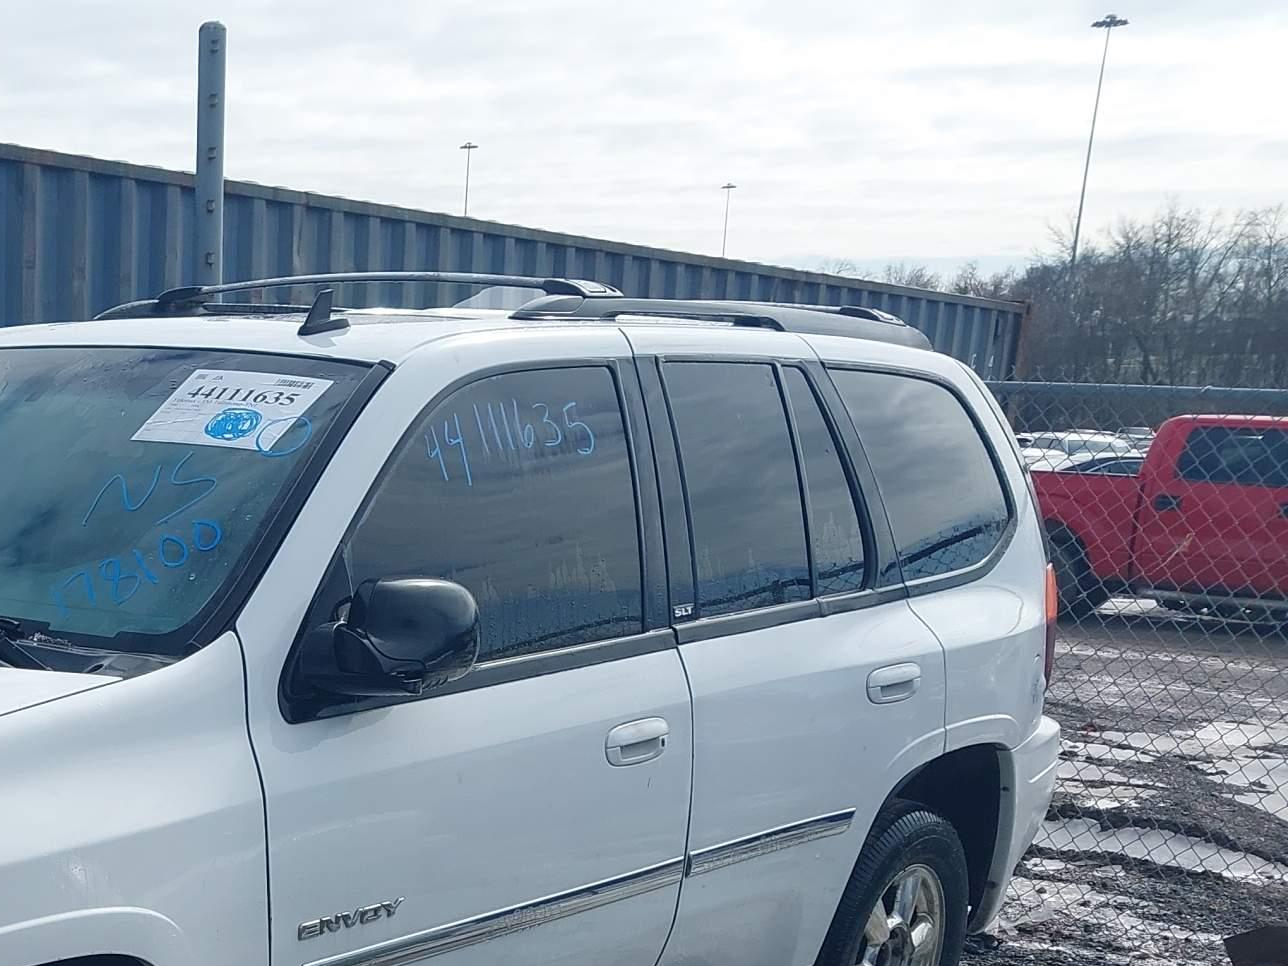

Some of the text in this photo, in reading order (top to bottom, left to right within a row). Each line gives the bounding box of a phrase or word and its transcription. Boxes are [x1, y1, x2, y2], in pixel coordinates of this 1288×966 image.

[187, 386, 300, 406] 44111635
[674, 606, 693, 618] SLT
[297, 896, 405, 941] ENVOY
